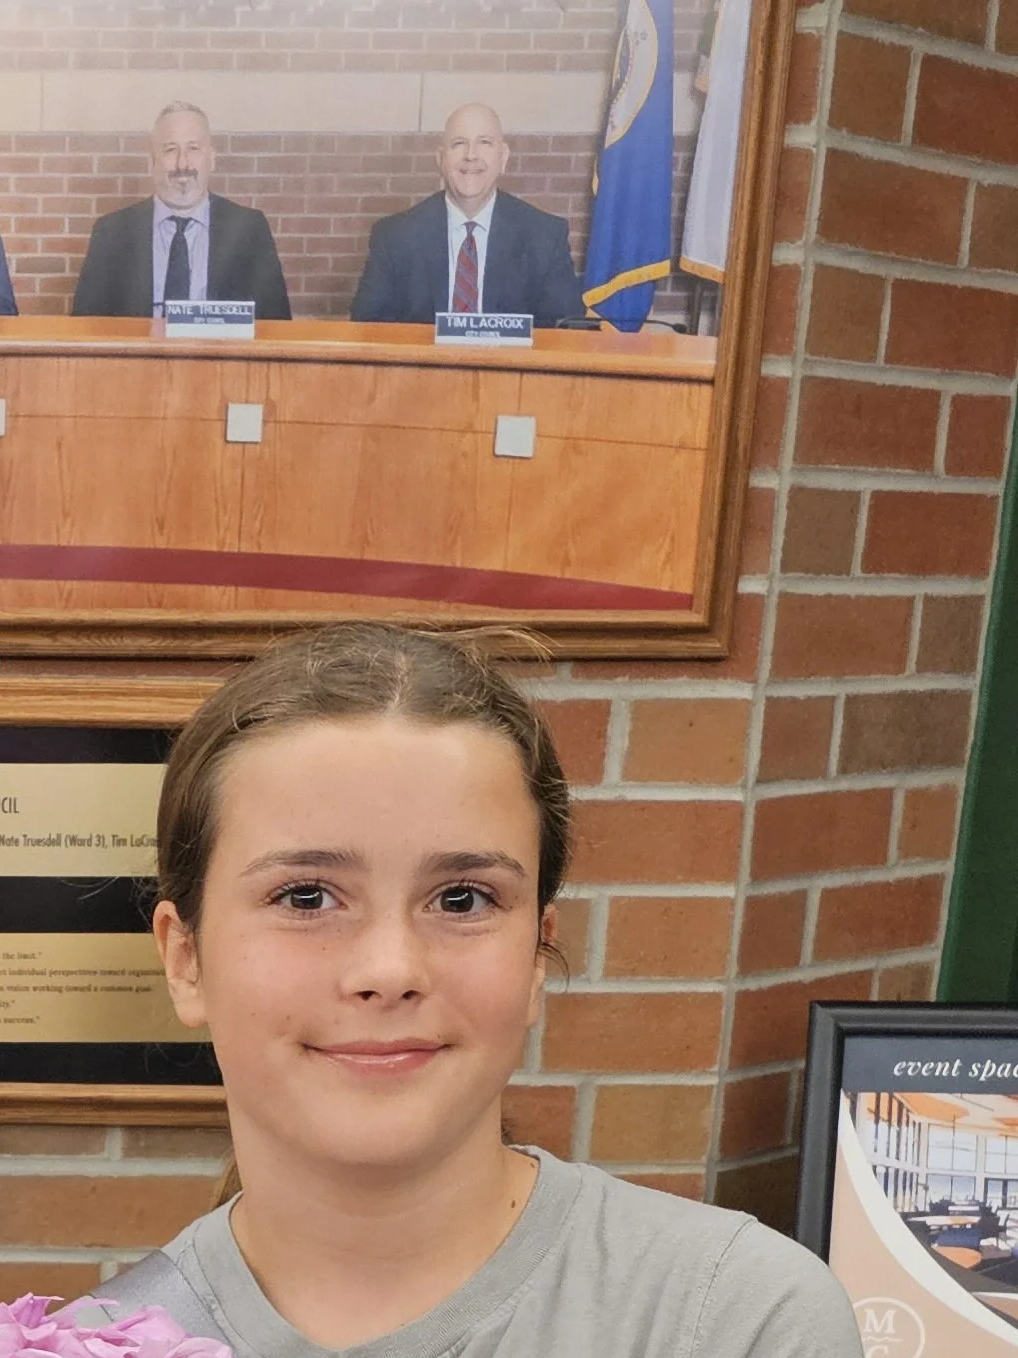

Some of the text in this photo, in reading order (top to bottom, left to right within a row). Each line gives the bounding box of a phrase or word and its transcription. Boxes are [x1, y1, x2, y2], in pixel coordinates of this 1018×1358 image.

[167, 304, 193, 315] NATE
[446, 317, 467, 327] TIM
[22, 834, 62, 846] Truesdell
[64, 834, 92, 848] (Ward
[111, 834, 128, 847] Tim
[893, 1058, 962, 1077] event
